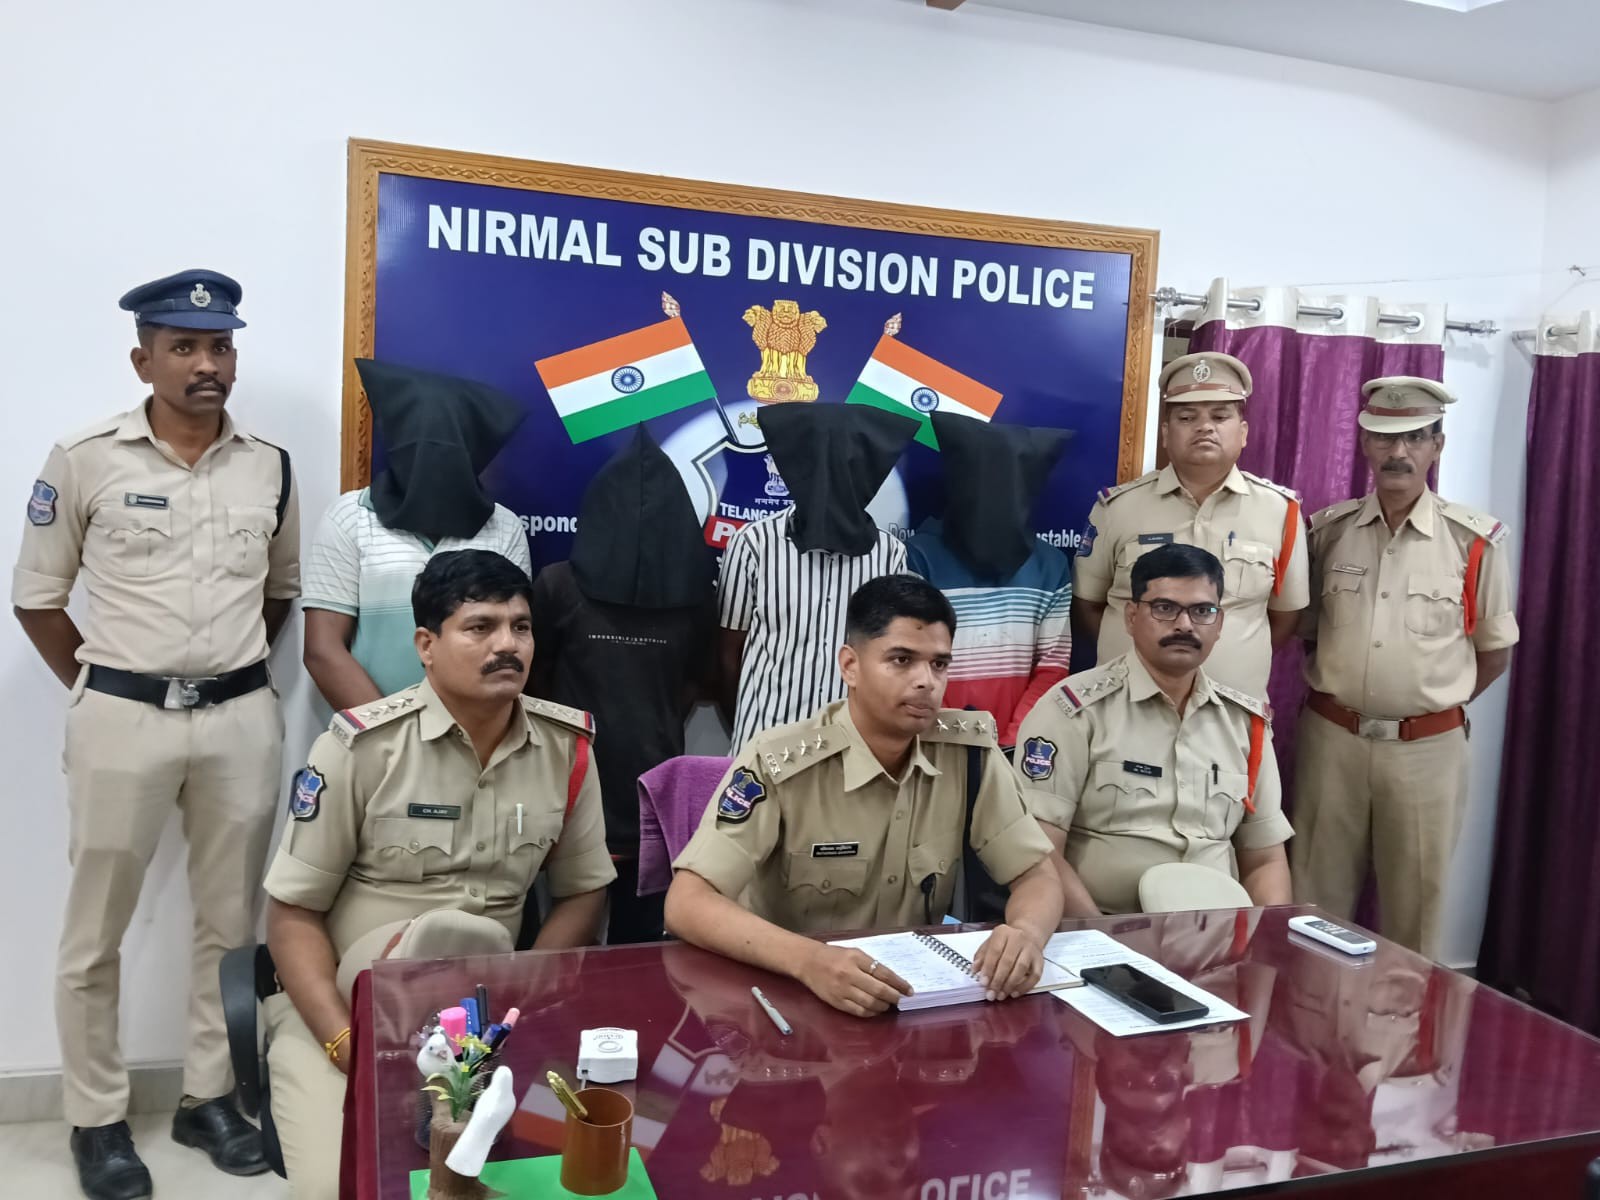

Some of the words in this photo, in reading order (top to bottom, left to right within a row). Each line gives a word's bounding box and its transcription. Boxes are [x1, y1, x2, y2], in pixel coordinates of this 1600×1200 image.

[428, 204, 622, 267] NIRMAL
[637, 226, 731, 277] SUB
[747, 238, 938, 297] DIVISION
[952, 259, 1095, 310] POLICE
[719, 502, 782, 521] TELANGA
[1036, 529, 1081, 548] stable
